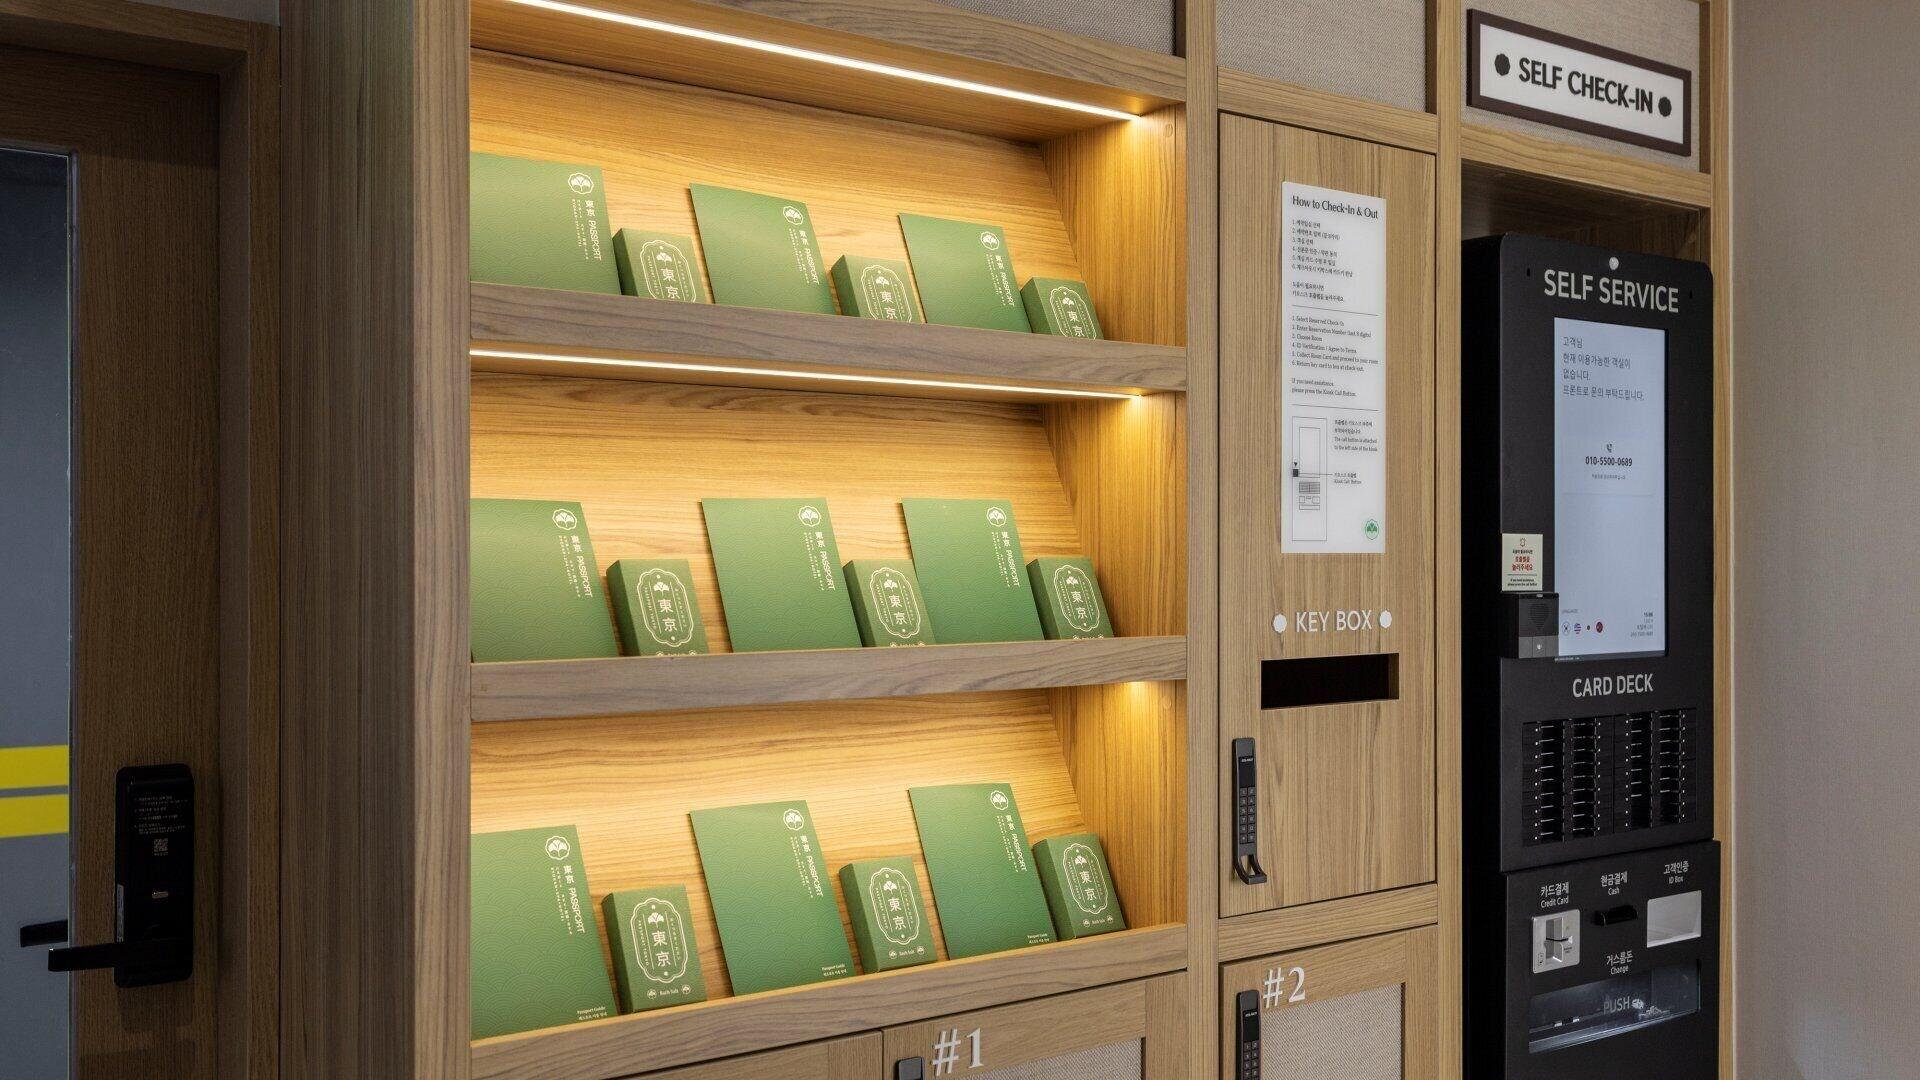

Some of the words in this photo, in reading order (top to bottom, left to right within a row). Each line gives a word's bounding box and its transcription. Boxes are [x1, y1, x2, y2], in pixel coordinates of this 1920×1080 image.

[1519, 58, 1562, 90] SELF
[1568, 71, 1653, 114] CHECK-IN
[1292, 195, 1310, 207] How
[1312, 200, 1320, 209] to
[1322, 201, 1354, 214] Check-In
[1356, 207, 1362, 216] &
[1364, 208, 1378, 219] Out
[588, 220, 602, 261] PASSPORT
[805, 248, 819, 285] PASSPORT
[660, 268, 680, 299] 東京
[1001, 272, 1015, 307] PASSPORT
[1544, 270, 1593, 300] SELF
[1599, 277, 1679, 313] SERVICE
[880, 291, 898, 319] 東京
[1067, 311, 1085, 337] 東京
[1562, 336, 1583, 350] 고객님
[1563, 352, 1576, 364] 현재
[1577, 353, 1610, 367] 이용가능한
[1612, 356, 1631, 370] 객실이
[1563, 368, 1591, 381] 없습니다.
[1563, 384, 1589, 397] 프론트로
[1590, 385, 1604, 398] 문의
[1605, 386, 1645, 401] 부탁드립니다.
[577, 556, 593, 598] PASSPORT
[820, 551, 835, 590] PASSPORT
[1006, 550, 1020, 587] PASSPORT
[658, 599, 677, 632] 東京
[889, 595, 907, 625] 東京
[1071, 591, 1088, 619] 東京
[1296, 611, 1330, 633] KEY
[1336, 609, 1373, 631] BOX
[1572, 676, 1613, 698] CARD
[1617, 673, 1653, 695] DECK
[1012, 833, 1027, 872] PASSPORT
[807, 855, 823, 897] PASSPORT
[1601, 871, 1628, 887] 현금결제
[1664, 861, 1689, 875] 고객인증
[1675, 876, 1683, 884] Box
[563, 865, 575, 883] 東京
[569, 887, 585, 933] PASSPORT
[1080, 871, 1096, 901] 東京
[1541, 882, 1569, 898] 카드결제
[1608, 887, 1620, 896] Cash
[888, 898, 906, 931] 東京
[1541, 899, 1556, 908] Credit
[1557, 897, 1569, 906] Card
[652, 931, 671, 967] 東京
[1606, 950, 1633, 966] 거스름돈
[1610, 965, 1628, 975] Change
[1263, 966, 1306, 1009] #2
[1604, 996, 1629, 1014] PUSH
[932, 1027, 985, 1077] #1
